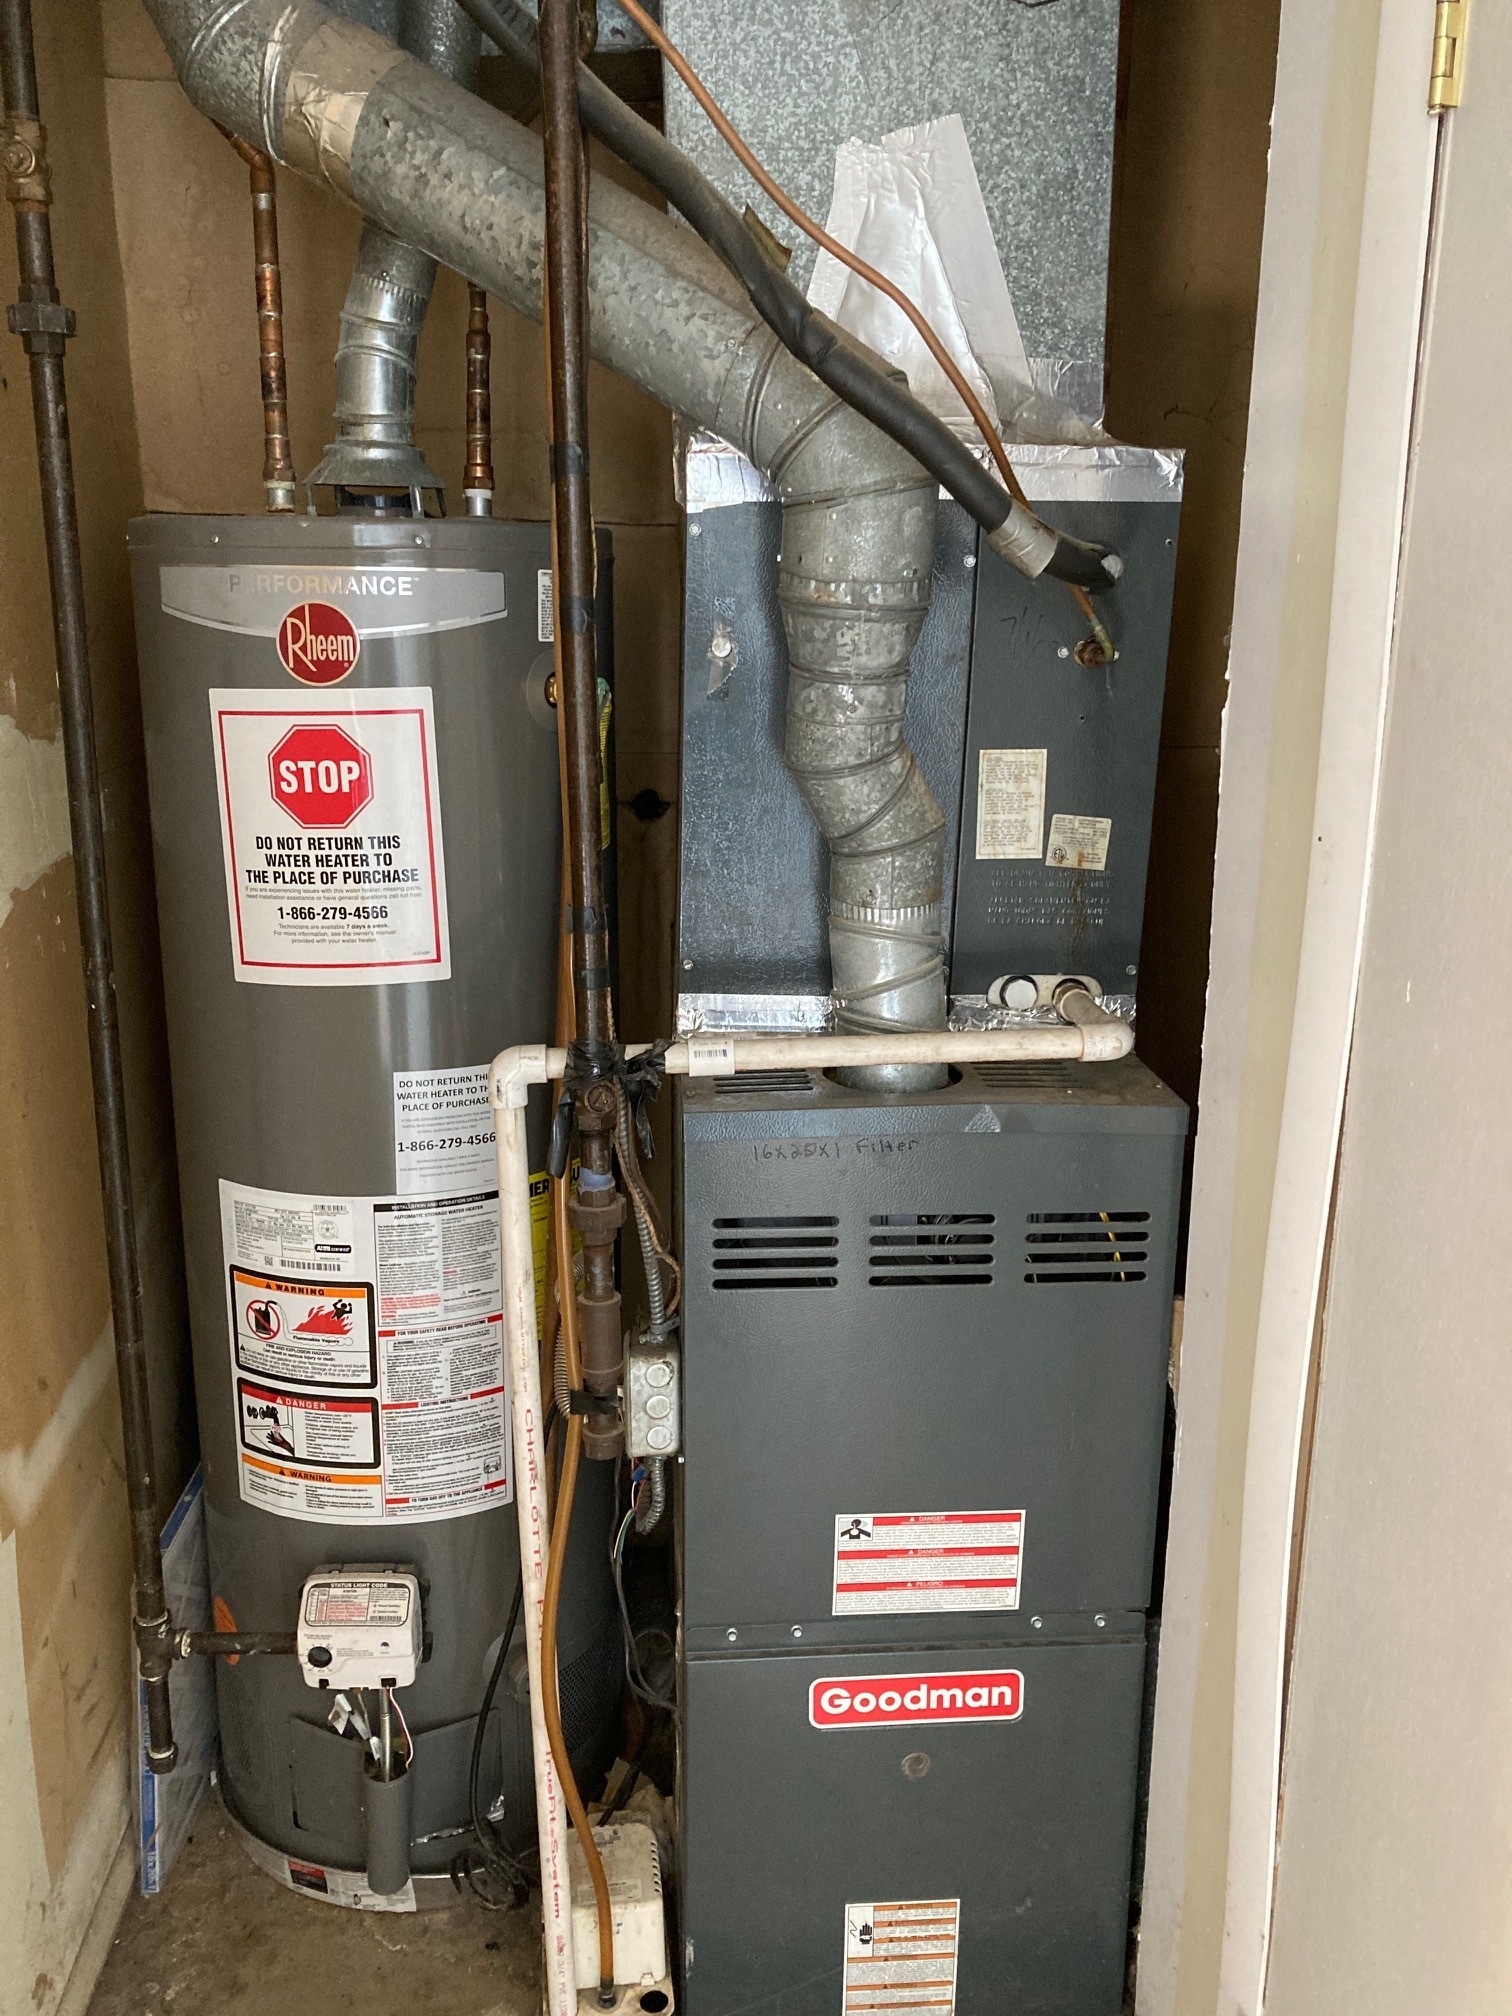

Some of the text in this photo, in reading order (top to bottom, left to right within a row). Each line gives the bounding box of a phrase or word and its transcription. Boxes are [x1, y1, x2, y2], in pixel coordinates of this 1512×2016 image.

[287, 603, 354, 672] Rheem
[279, 760, 360, 793] STOP
[256, 835, 400, 850] DO NOT RETURN THIS
[265, 853, 392, 867] WATER HEATER TO
[246, 869, 419, 885] THE PLACE OF PURCHASE
[278, 906, 388, 920] 1-866-279-4566
[437, 1076, 472, 1086] RETURN
[397, 1091, 428, 1100] WATER
[431, 1088, 464, 1098] HEATER
[402, 1103, 429, 1112] PLACE
[398, 1132, 496, 1152] 1-866-279-4566
[856, 1138, 918, 1154] Filter
[276, 1284, 325, 1296] WARNING
[285, 1398, 326, 1410] DANGER
[290, 1470, 332, 1482] WARNING
[525, 1408, 543, 1579] CHARLOTTE
[820, 1684, 1012, 1715] Goodman
[552, 1839, 560, 1919] System
